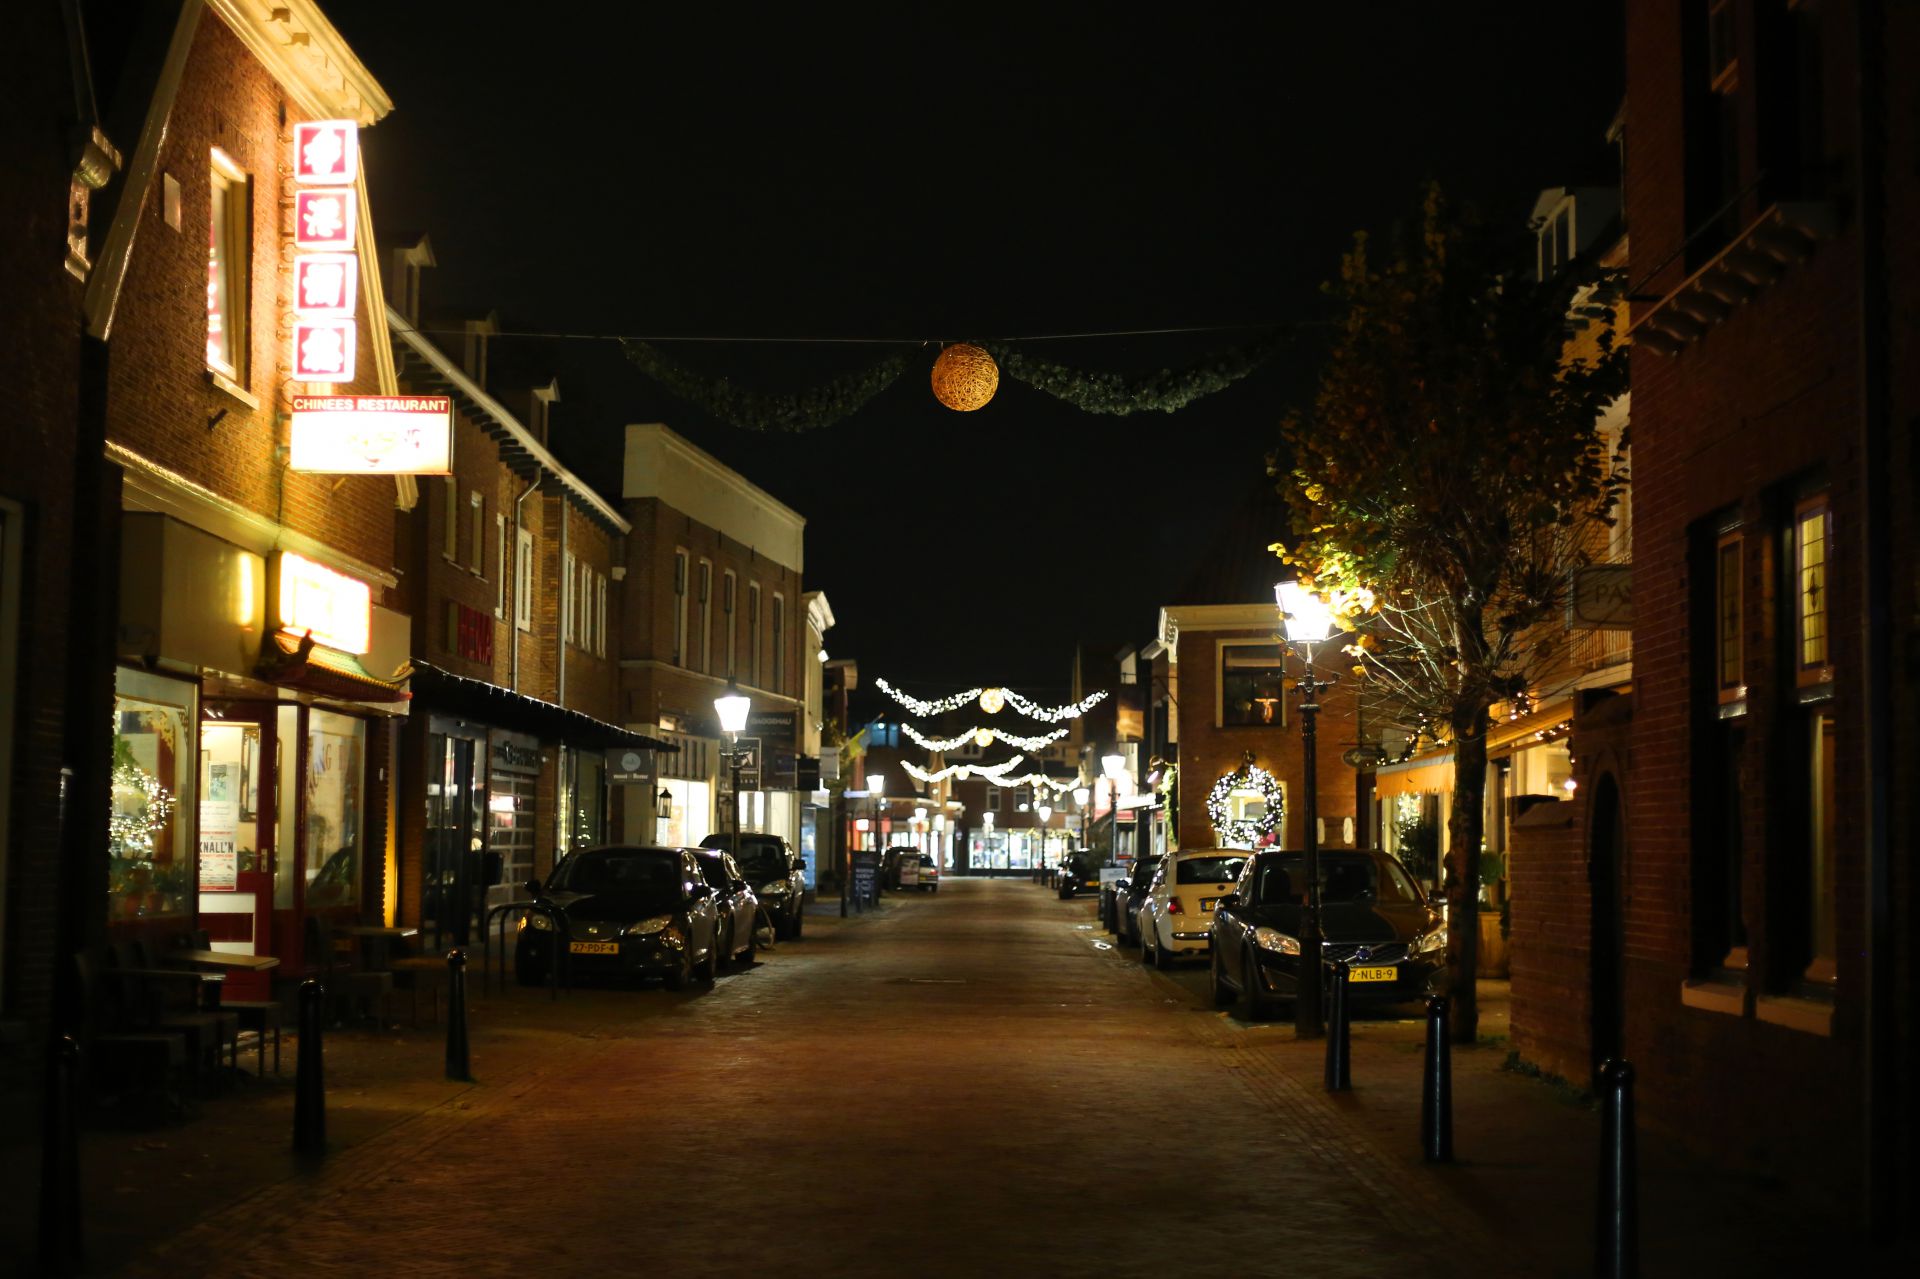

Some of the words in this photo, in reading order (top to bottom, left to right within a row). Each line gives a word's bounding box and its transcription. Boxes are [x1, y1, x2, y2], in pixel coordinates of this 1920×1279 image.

[293, 398, 353, 410] CHINEES
[356, 398, 447, 411] RESTAURANT
[1595, 583, 1632, 604] PA
[573, 943, 615, 953] 27-PDF-4
[1350, 968, 1393, 980] 7-NLB-9
